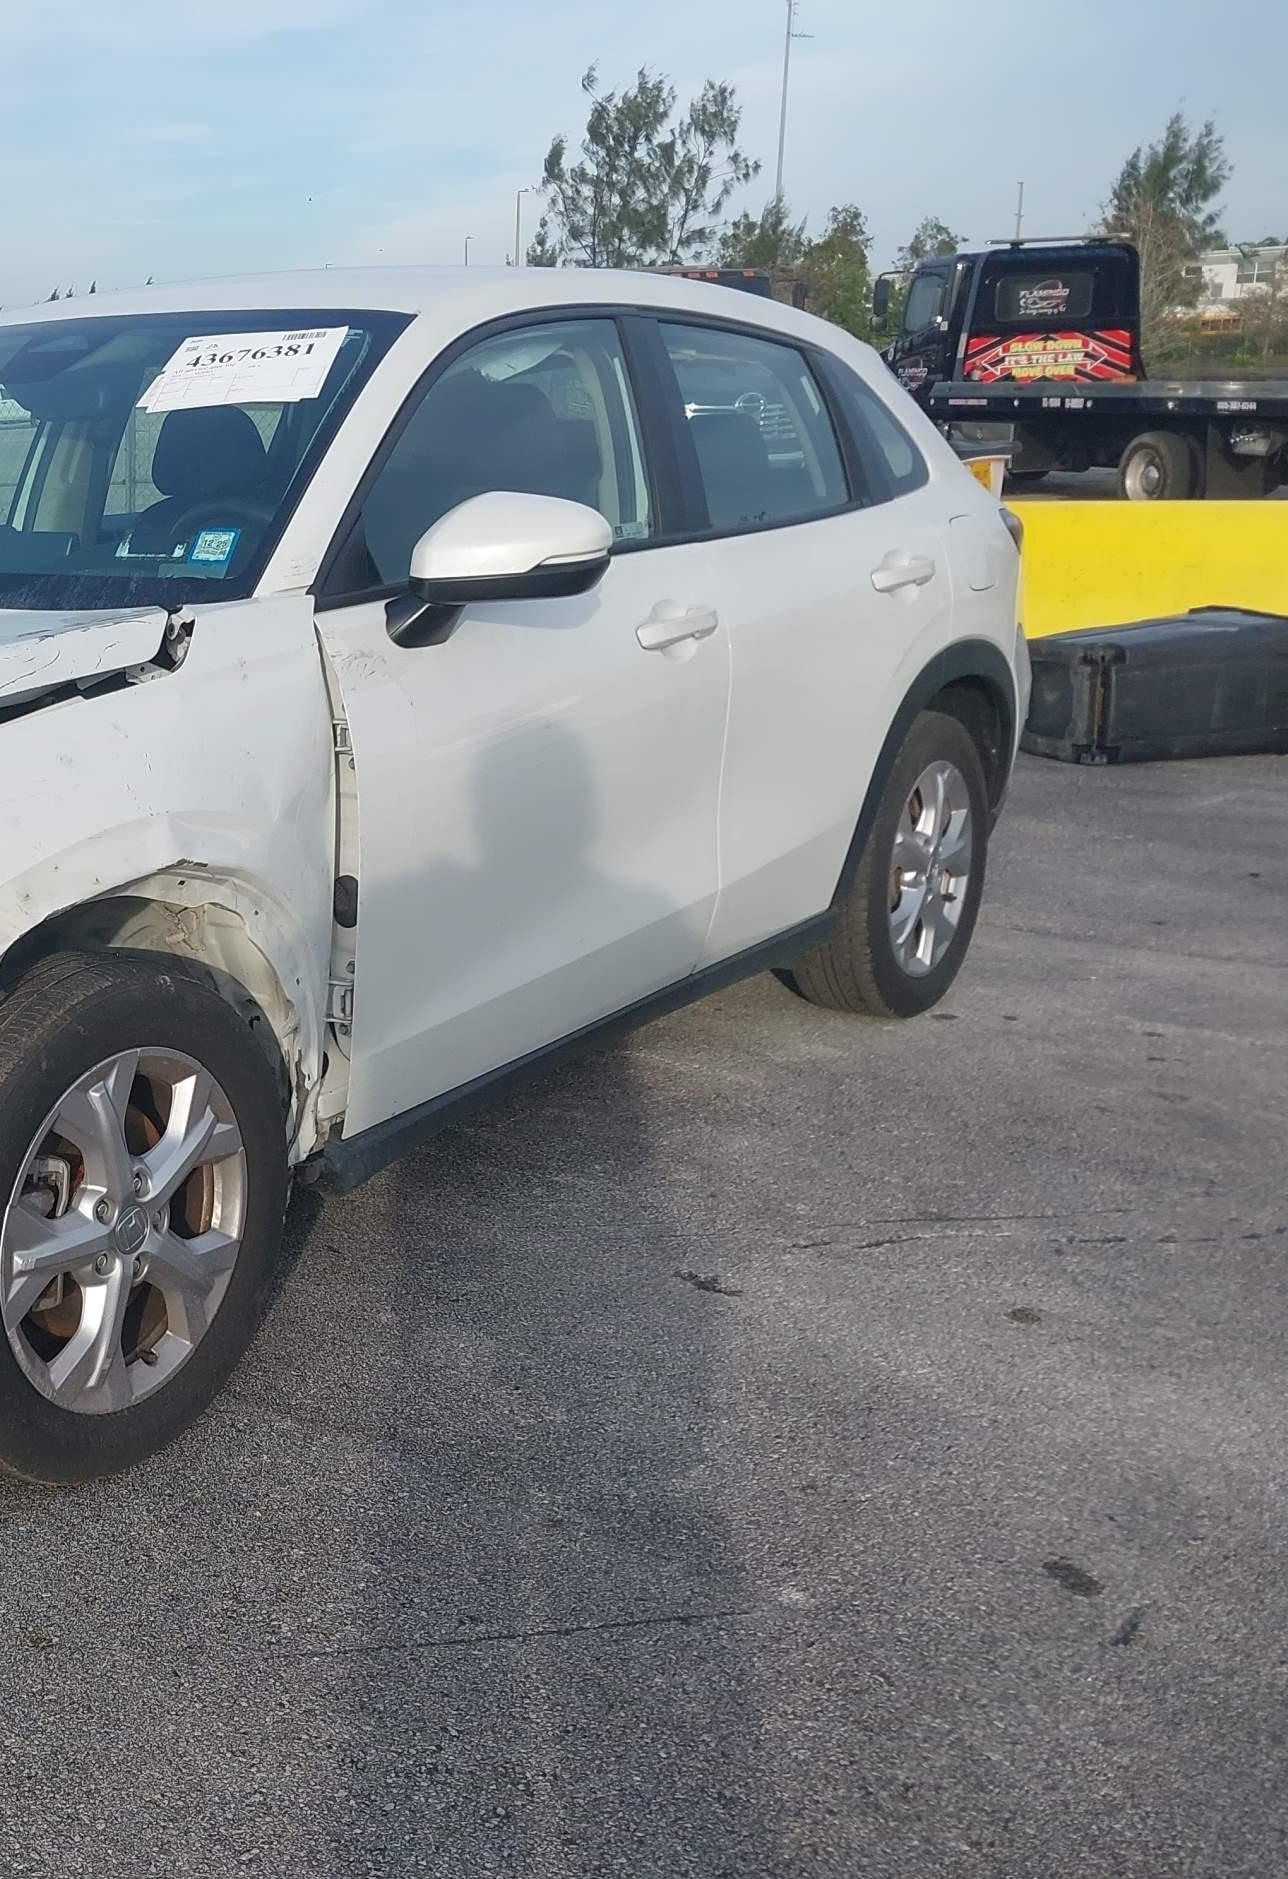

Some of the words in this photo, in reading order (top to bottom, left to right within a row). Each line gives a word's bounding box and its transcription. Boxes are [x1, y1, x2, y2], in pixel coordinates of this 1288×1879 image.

[186, 343, 315, 368] 43676381
[1032, 353, 1055, 364] THE
[1057, 351, 1086, 362] LAW
